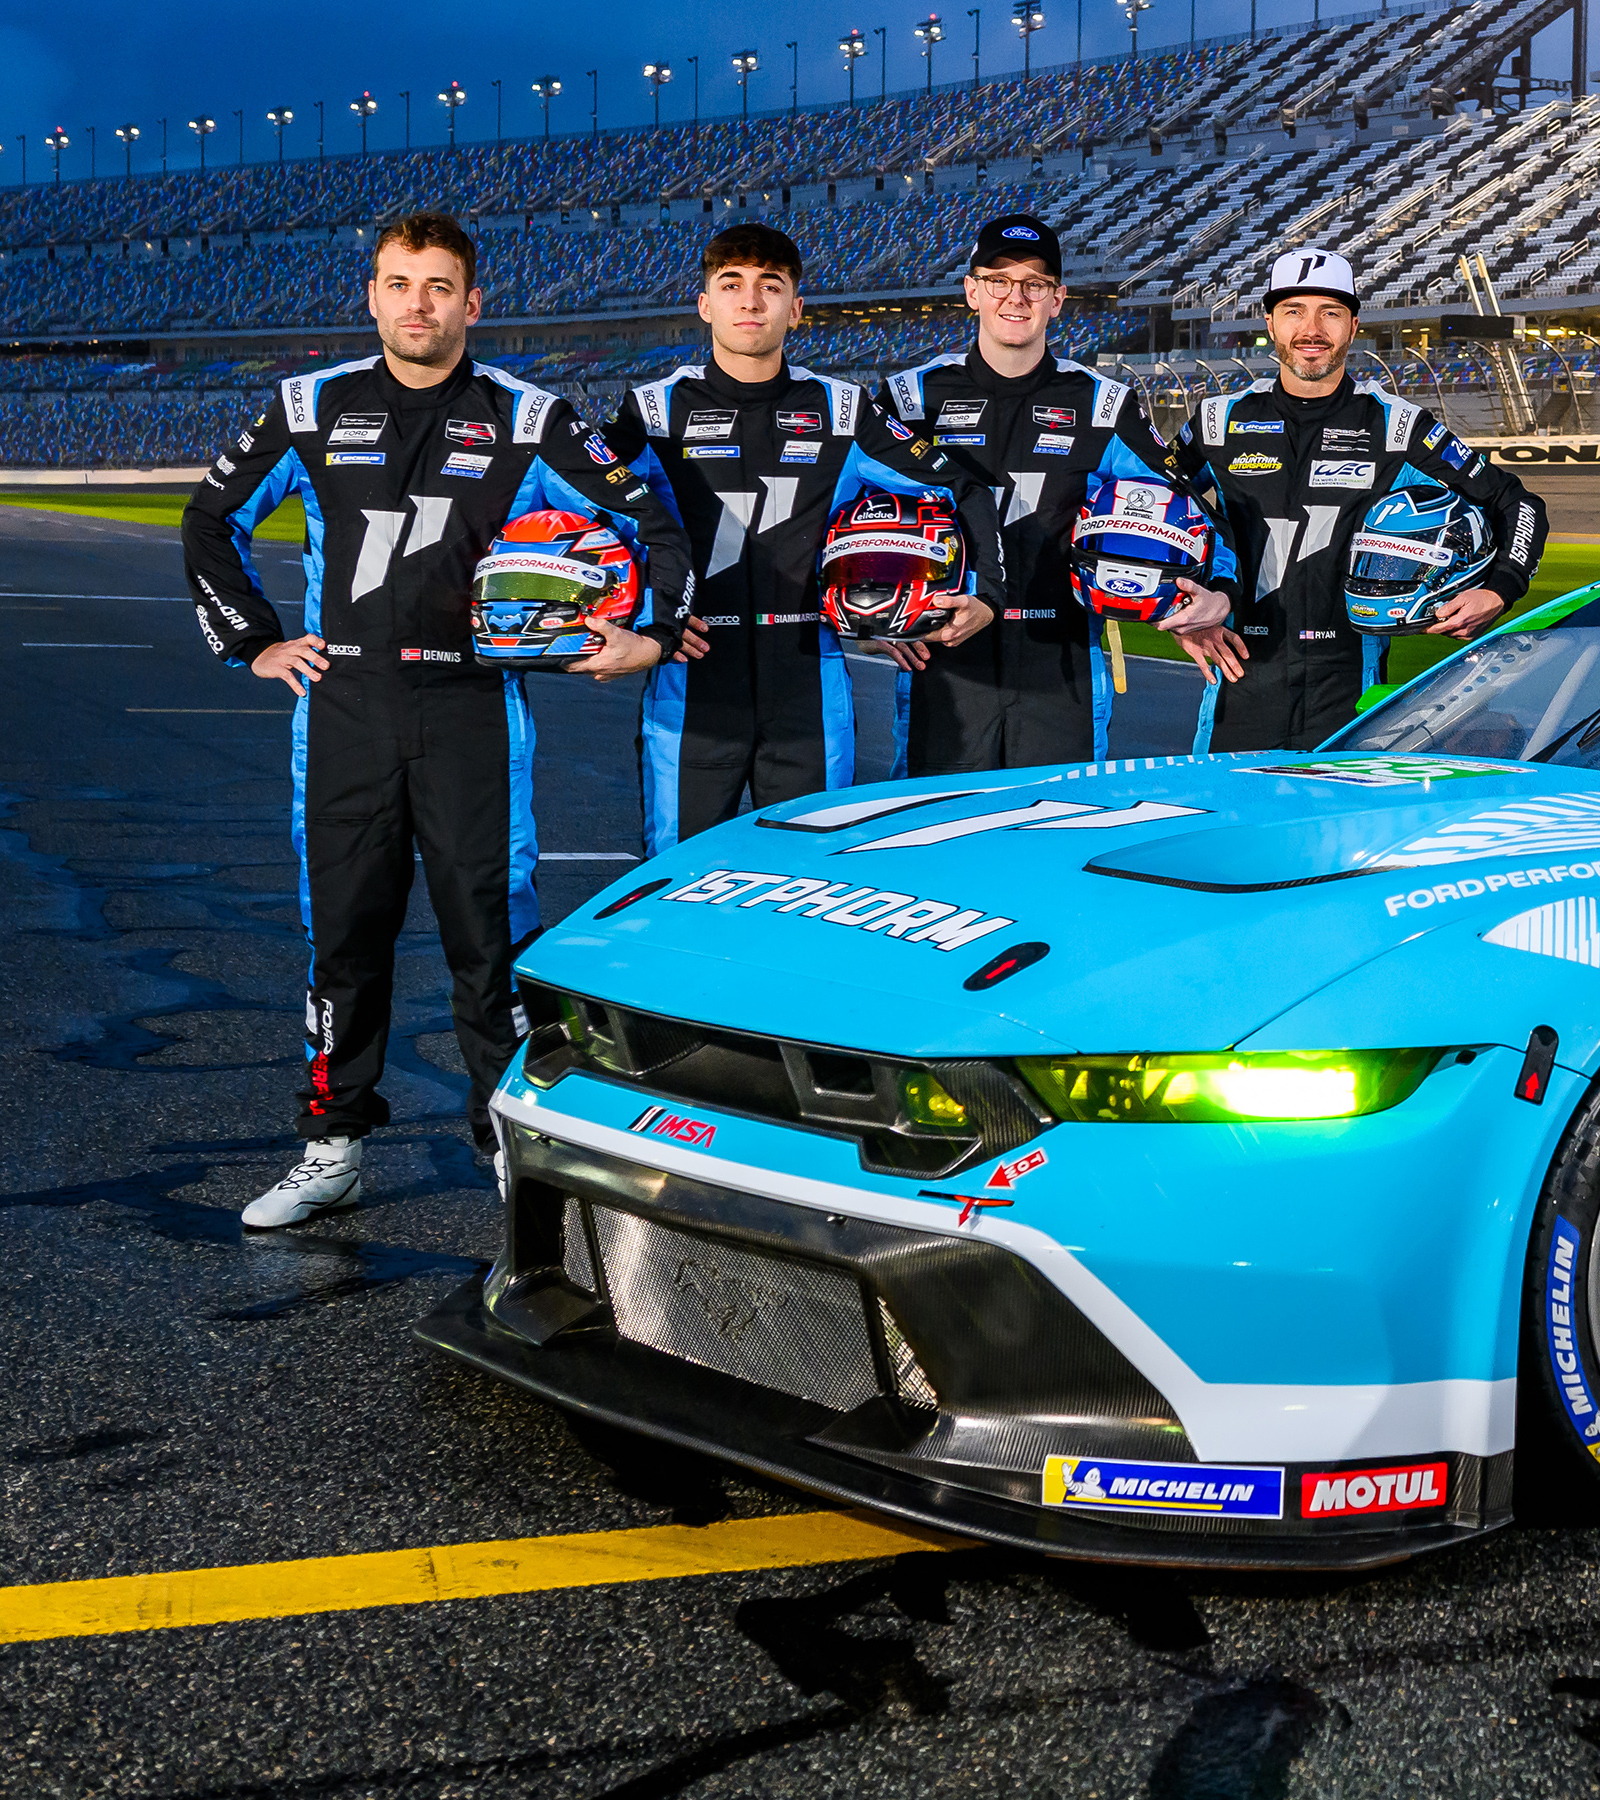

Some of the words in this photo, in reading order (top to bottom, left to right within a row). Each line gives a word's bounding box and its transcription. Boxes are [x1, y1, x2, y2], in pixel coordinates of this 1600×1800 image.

[1009, 227, 1033, 238] Ford
[894, 375, 915, 413] sparco
[290, 381, 305, 423] sparco
[643, 389, 661, 430] sparco
[838, 388, 852, 430] sparco
[1100, 384, 1121, 420] sparco
[523, 395, 548, 436] sparco
[1232, 456, 1278, 464] MOUNTAIN
[1314, 463, 1371, 476] WEC
[857, 511, 894, 521] elledue
[1110, 579, 1137, 594] Ford
[701, 615, 741, 625] sparco
[773, 612, 819, 623] GIAMMARCO
[1022, 608, 1056, 619] DENNIS
[542, 619, 561, 627] BELL
[1315, 630, 1336, 639] RYAN
[327, 644, 361, 655] sparco
[423, 650, 462, 662] DENNIS
[651, 1114, 718, 1149] IMSA
[1004, 1152, 1043, 1180] TOW
[1552, 1235, 1593, 1416] MICHELIN
[1110, 1476, 1255, 1502] MICHELIN
[1309, 1469, 1440, 1512] MOTUL
